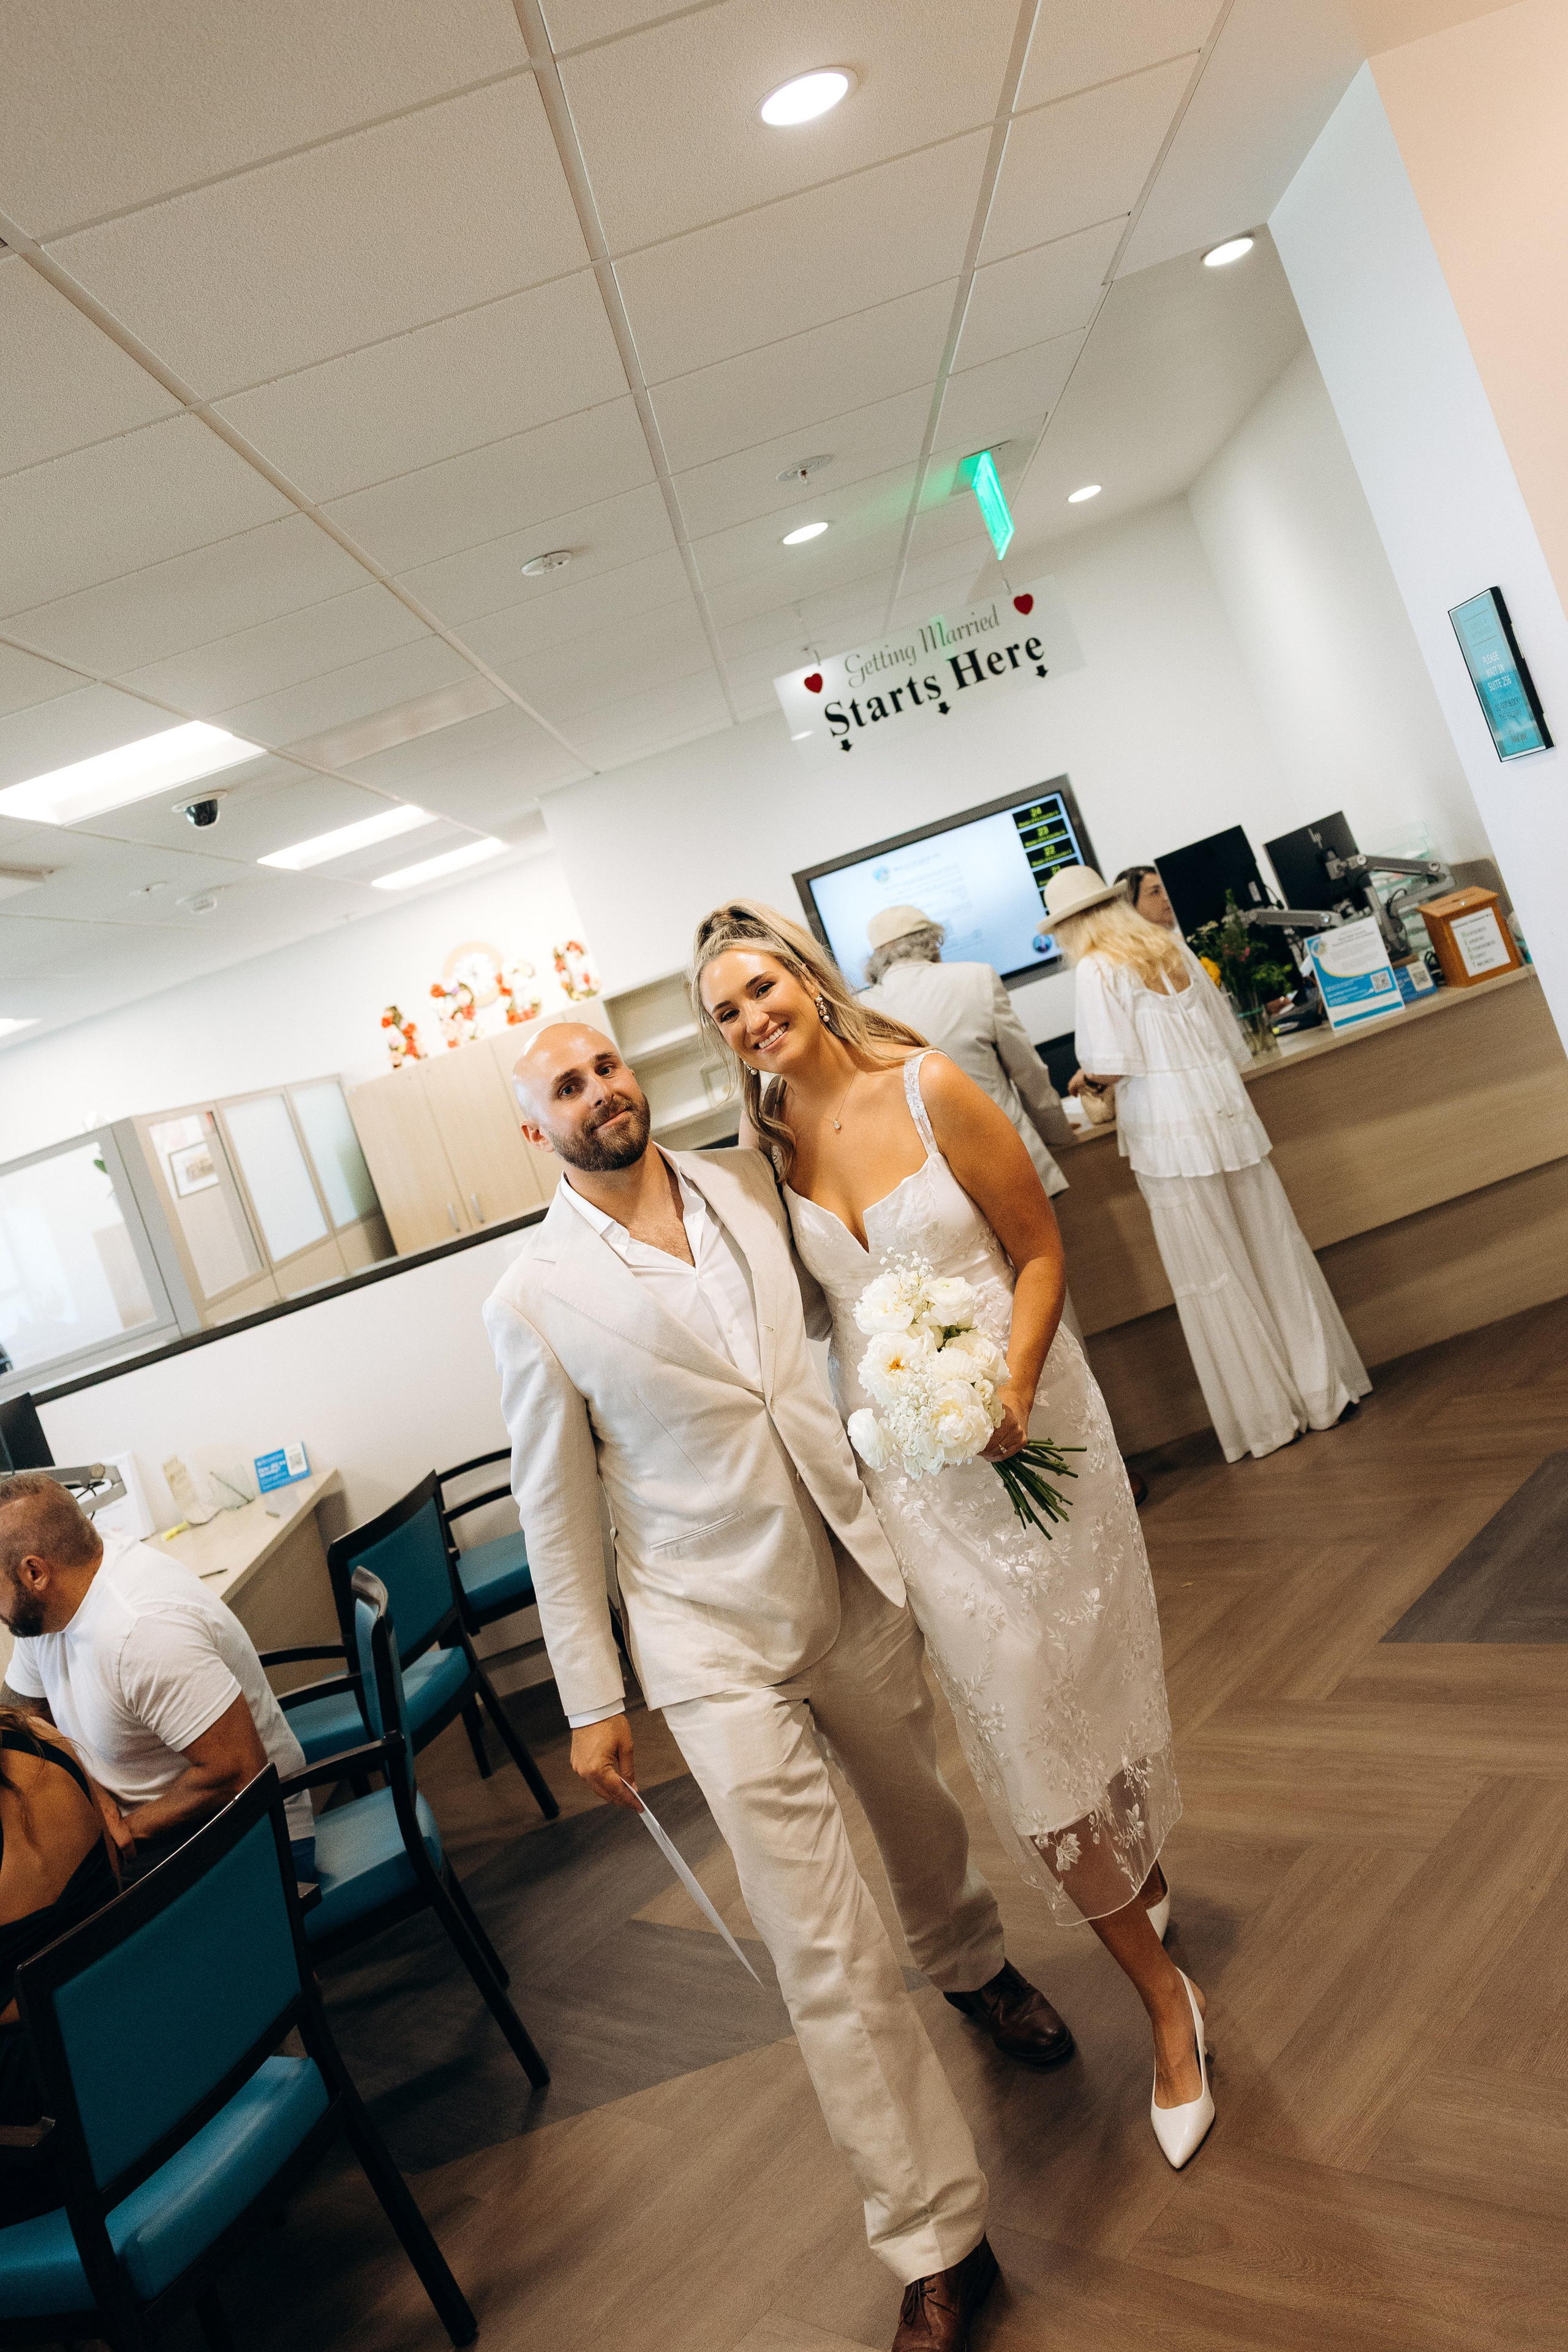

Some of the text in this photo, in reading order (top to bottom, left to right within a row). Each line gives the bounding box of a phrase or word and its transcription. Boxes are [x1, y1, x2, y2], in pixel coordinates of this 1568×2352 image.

[844, 603, 1000, 688] Getting Married
[1482, 651, 1500, 665] PLEASE
[1485, 665, 1496, 678] WAIT
[824, 637, 1044, 737] Starts Here
[1487, 674, 1512, 692] SUITE 256
